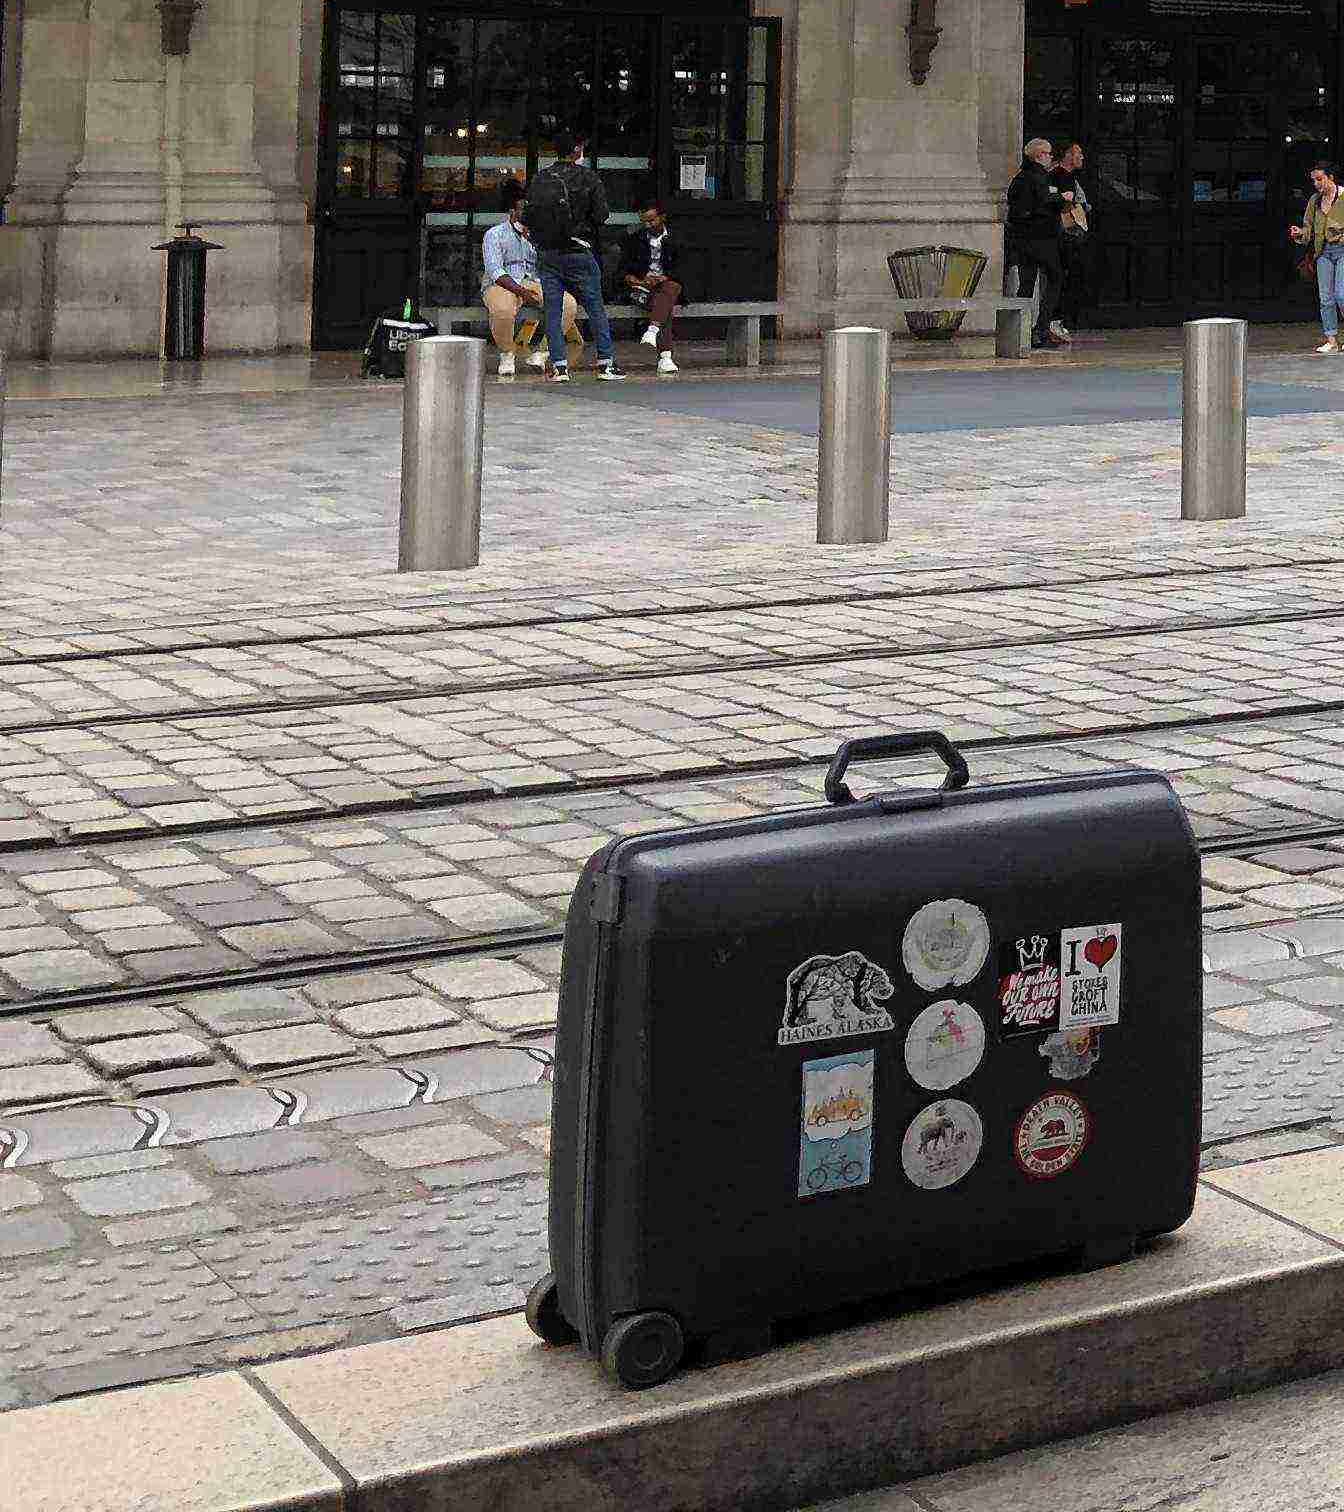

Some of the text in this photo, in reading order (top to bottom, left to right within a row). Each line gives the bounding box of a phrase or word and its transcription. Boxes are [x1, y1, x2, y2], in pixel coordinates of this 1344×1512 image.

[389, 329, 421, 339] Uber
[1065, 939, 1082, 977] I
[1072, 976, 1109, 991] STOKES
[1071, 988, 1106, 1004] CROFT
[1071, 1000, 1107, 1016] CHINA
[780, 1015, 892, 1043] HAINES ALASKA
